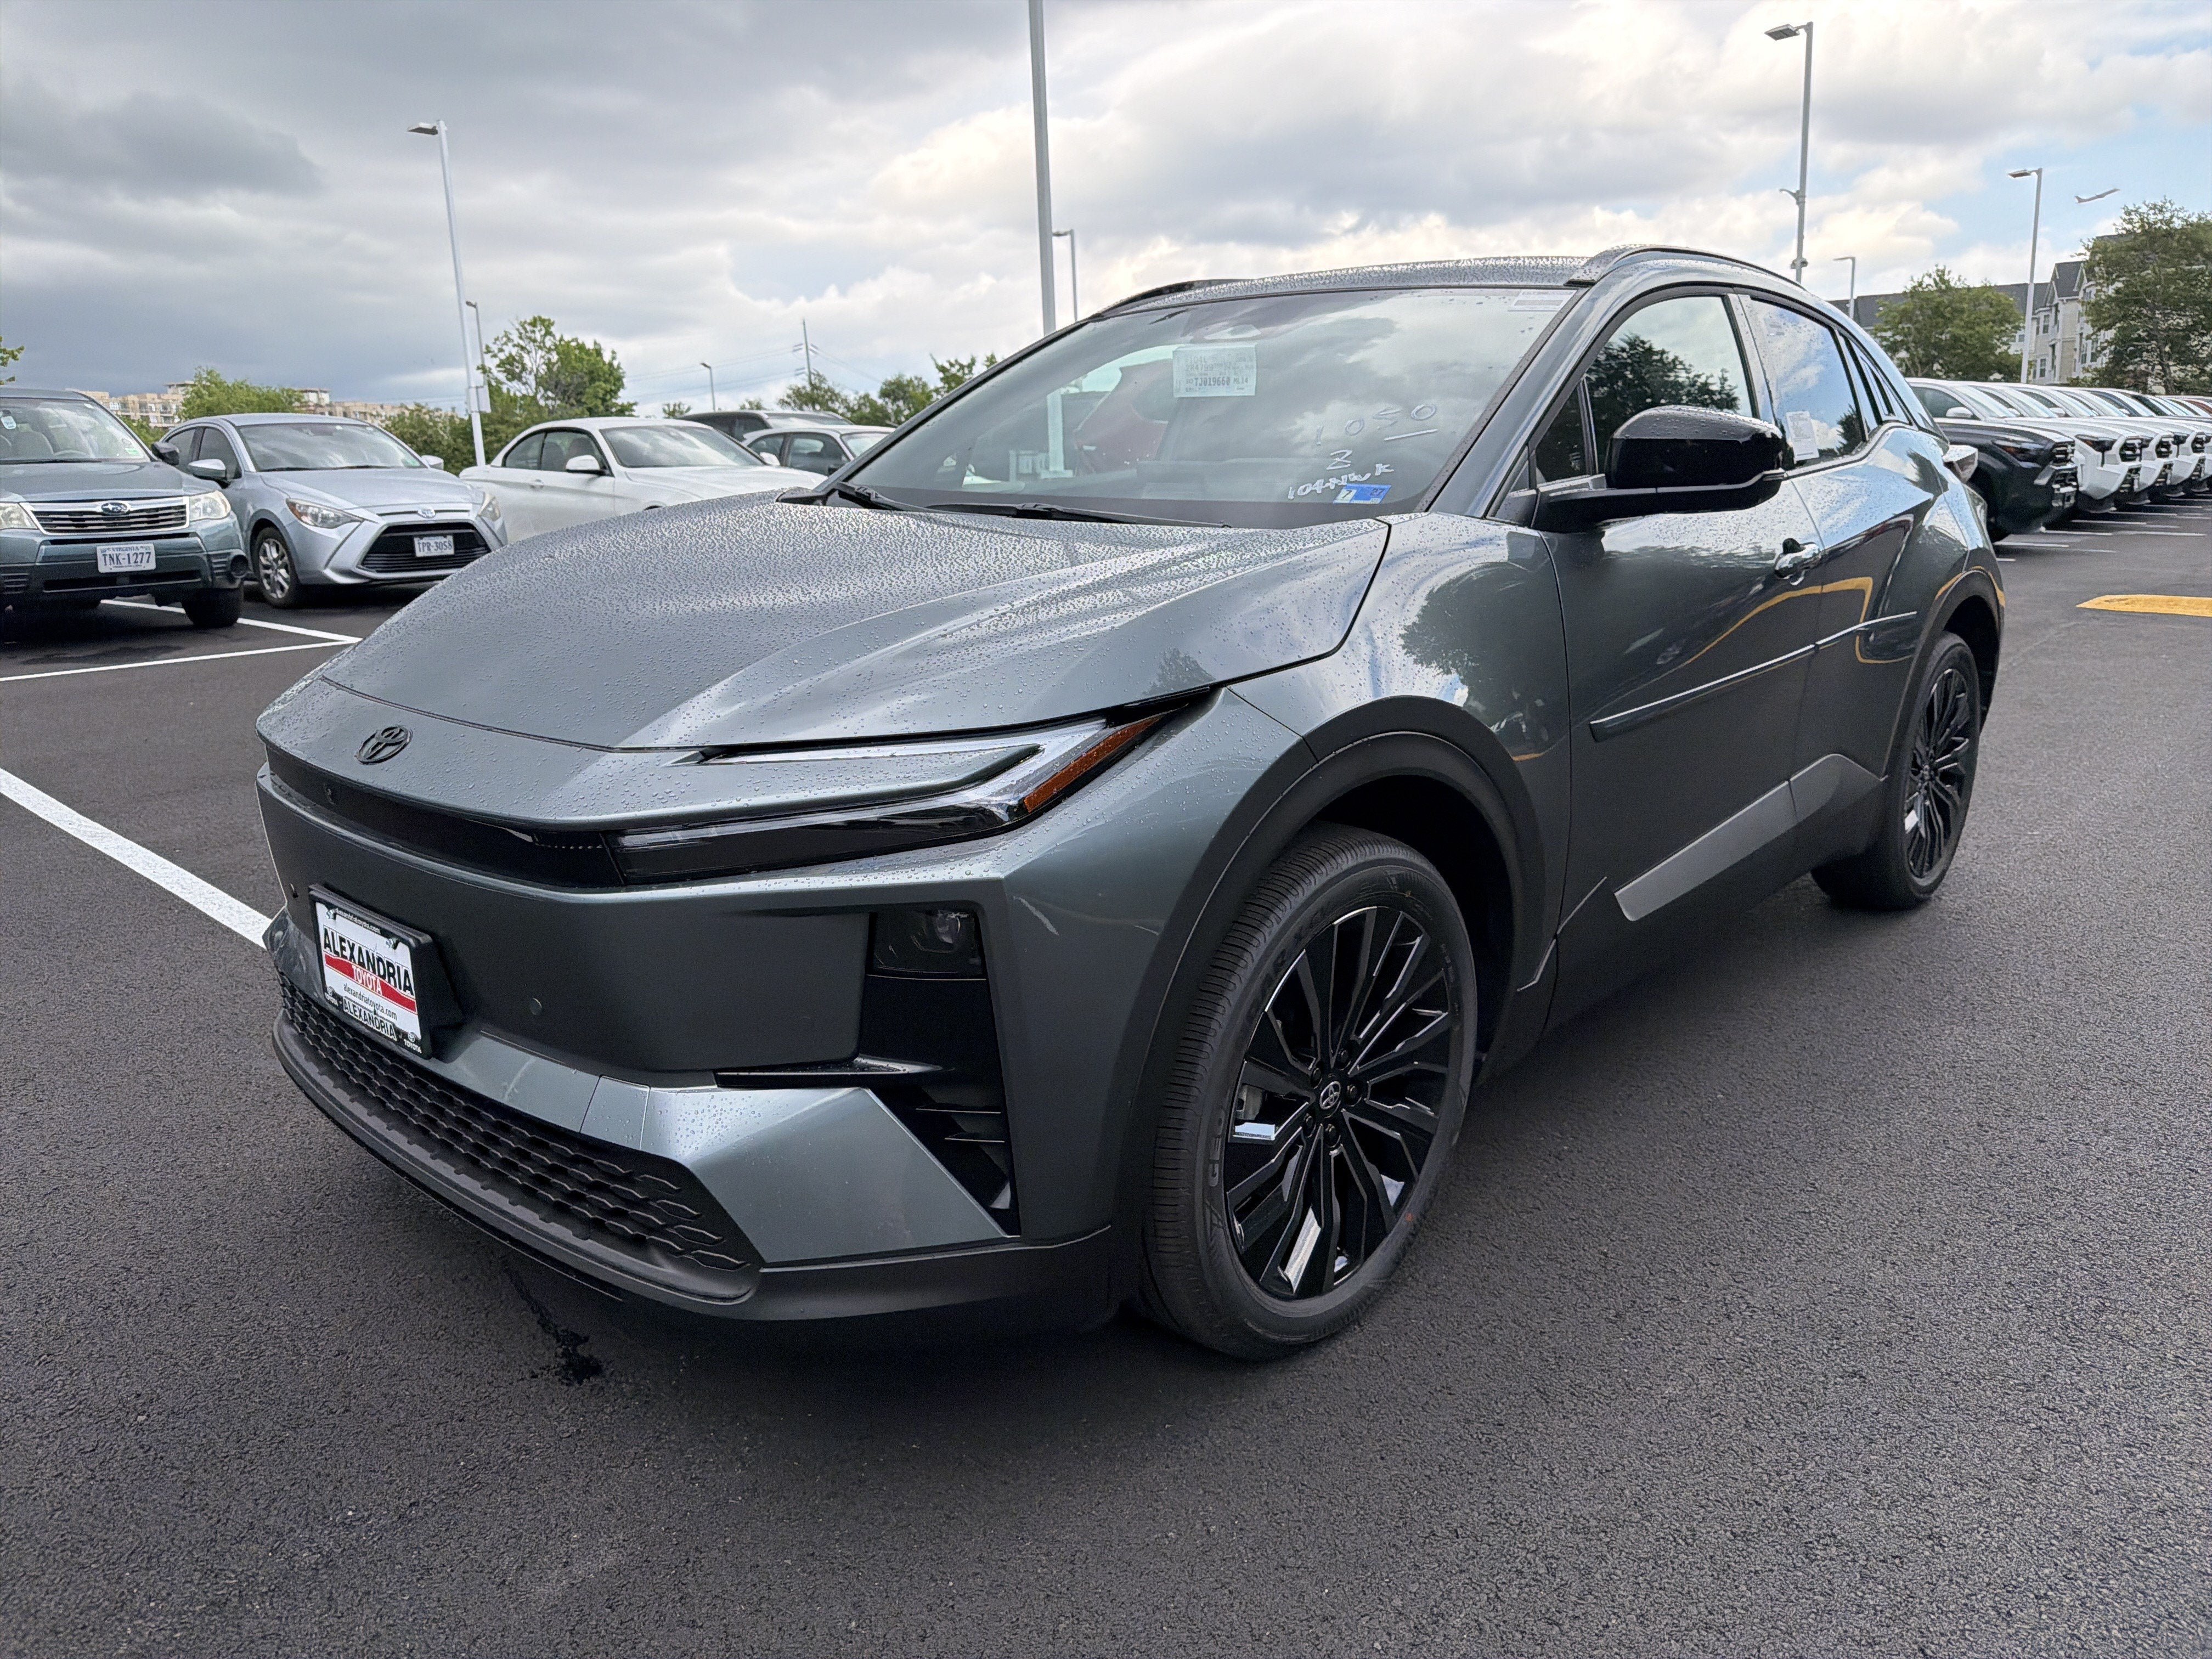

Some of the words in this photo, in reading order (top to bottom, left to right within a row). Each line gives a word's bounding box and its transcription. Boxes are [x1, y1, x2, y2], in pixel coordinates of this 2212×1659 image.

[1194, 376, 1231, 386] TJ019660
[1341, 489, 1353, 499] 7
[101, 551, 151, 566] TNK-1277
[324, 927, 415, 997] ALEXANDRIA
[352, 964, 383, 996] TOYOTA
[343, 983, 398, 1021] alexandriatoyota.com
[343, 997, 397, 1041] ALEXANDRIA
[403, 1039, 422, 1054] TOYOTA
